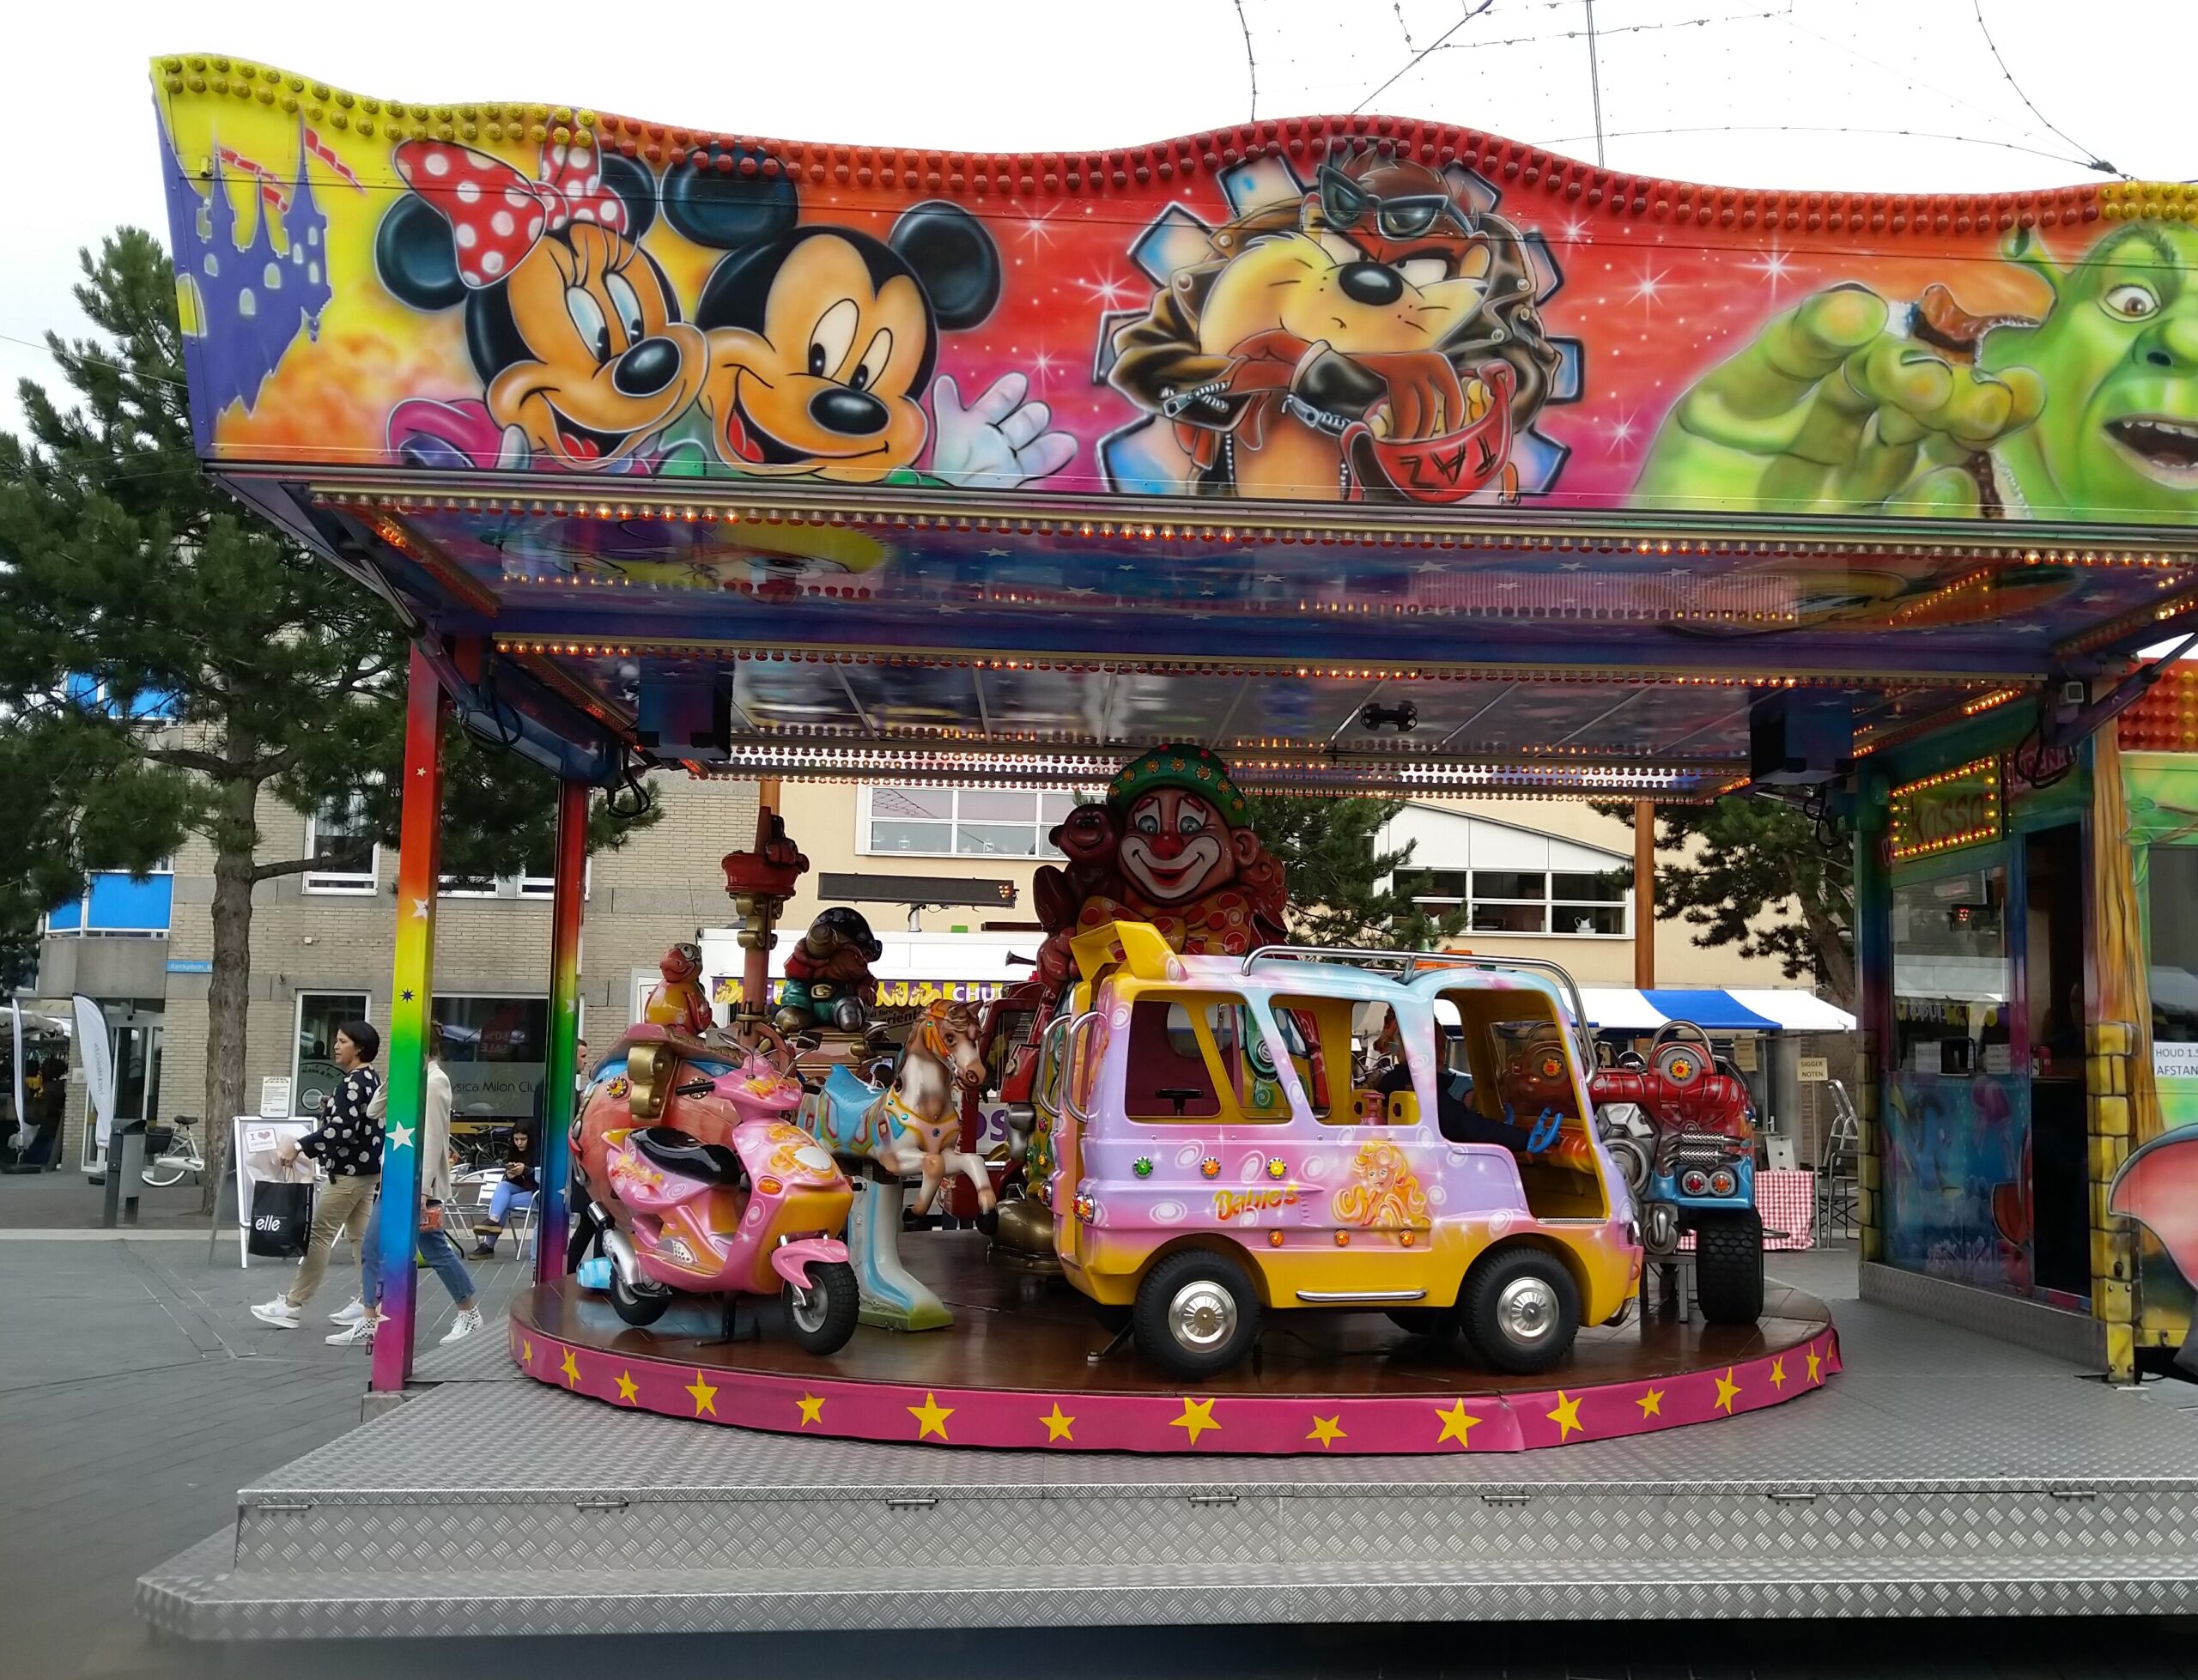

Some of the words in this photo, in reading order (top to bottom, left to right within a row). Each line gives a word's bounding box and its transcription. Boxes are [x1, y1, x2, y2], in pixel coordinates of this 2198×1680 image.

[1399, 434, 1497, 492] TAZ
[2156, 1048, 2184, 1057] HOUD
[2157, 1065, 2198, 1075] AFSTAN
[483, 1082, 515, 1092] Milon
[1212, 1185, 1299, 1222] Babies
[255, 1215, 281, 1231] elle
